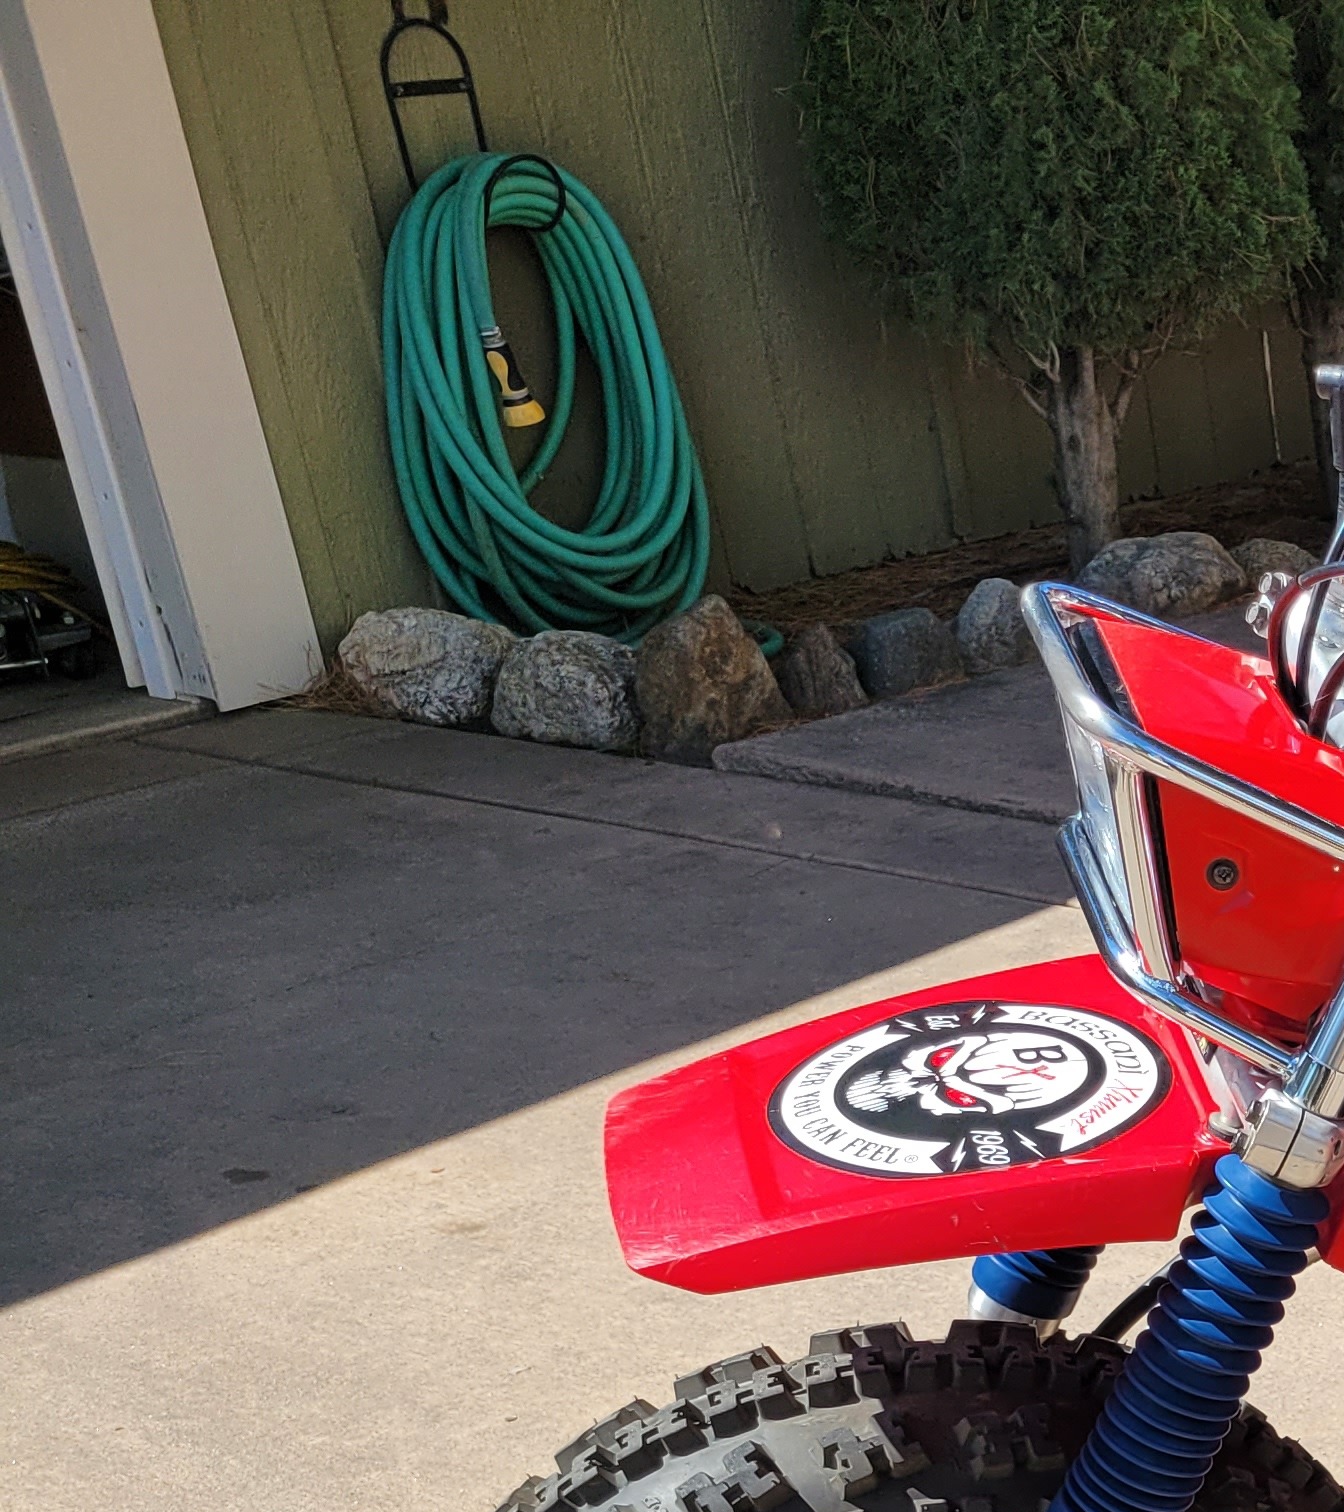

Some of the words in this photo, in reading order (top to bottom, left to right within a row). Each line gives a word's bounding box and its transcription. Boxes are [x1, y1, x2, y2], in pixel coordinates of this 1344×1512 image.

[797, 1044, 866, 1089] POWER
[793, 1090, 822, 1118] YOU
[802, 1117, 848, 1146] CAN
[839, 1137, 902, 1165] FEEL
[969, 1129, 1011, 1165] 1969
